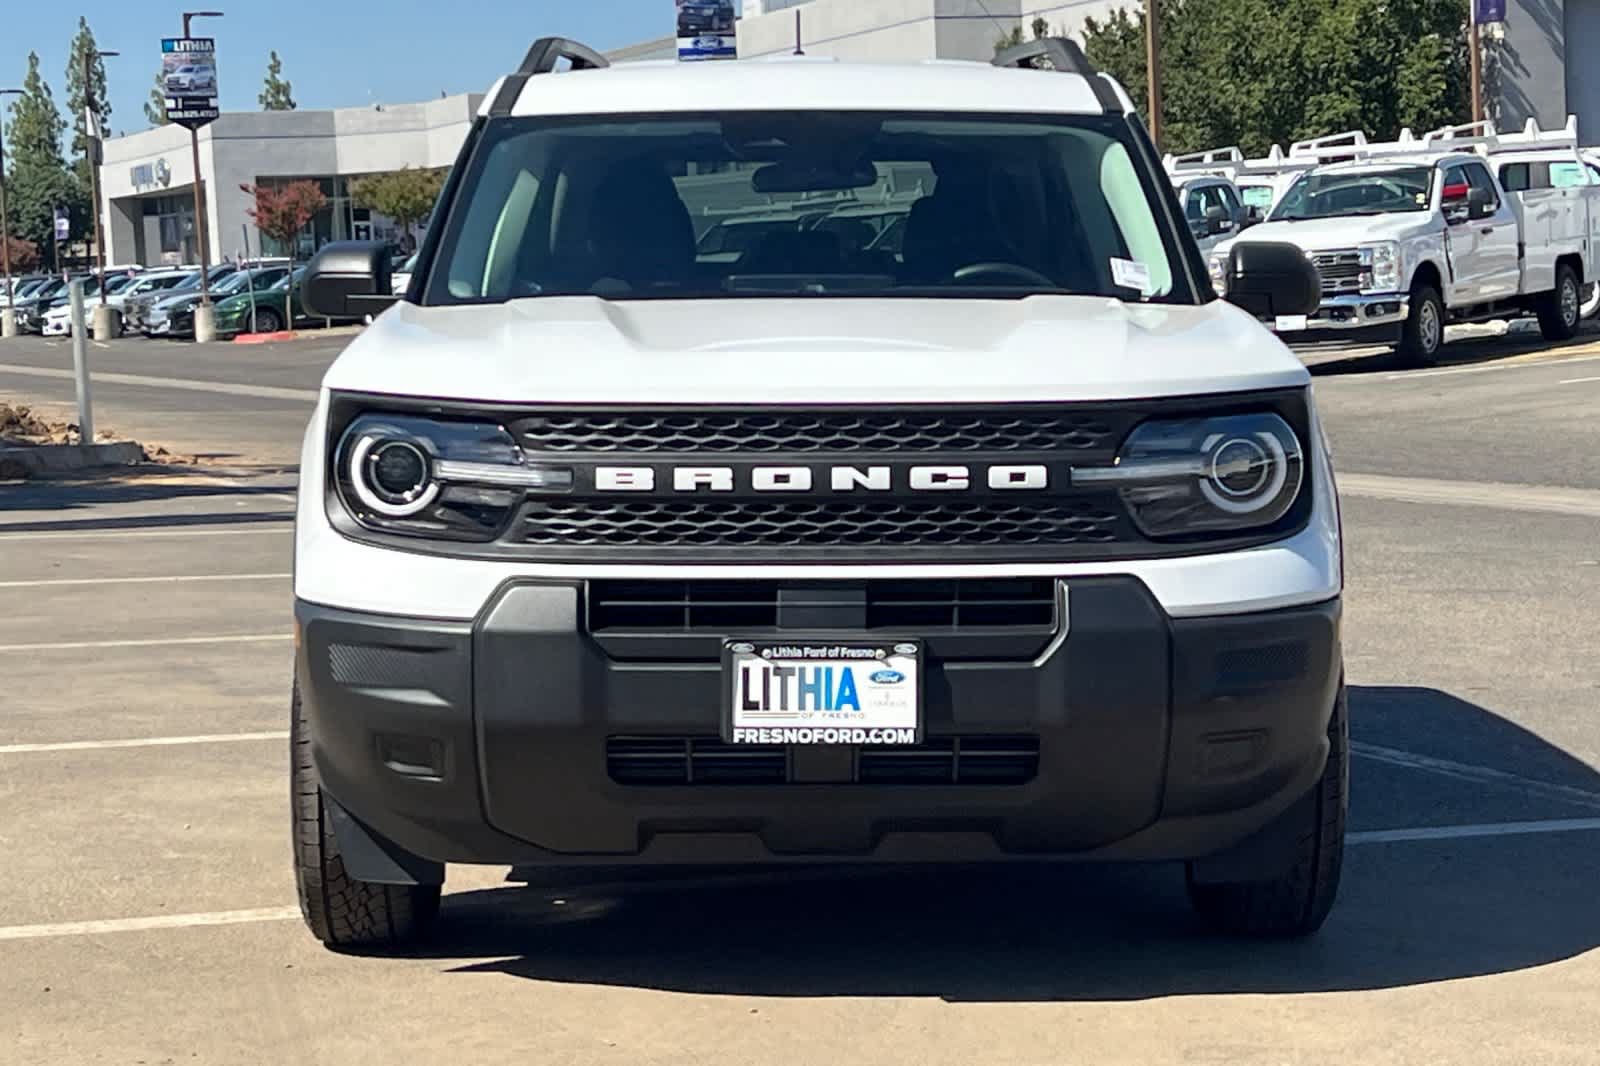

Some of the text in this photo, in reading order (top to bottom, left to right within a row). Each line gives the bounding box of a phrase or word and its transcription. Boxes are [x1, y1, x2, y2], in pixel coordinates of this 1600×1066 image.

[174, 40, 212, 51] LITHIA
[595, 466, 1047, 491] BRONCO
[772, 646, 875, 658] Lithia Ford of Fresno
[742, 667, 860, 711] LITHIA
[733, 729, 914, 744] FRESNOFORD.COM
